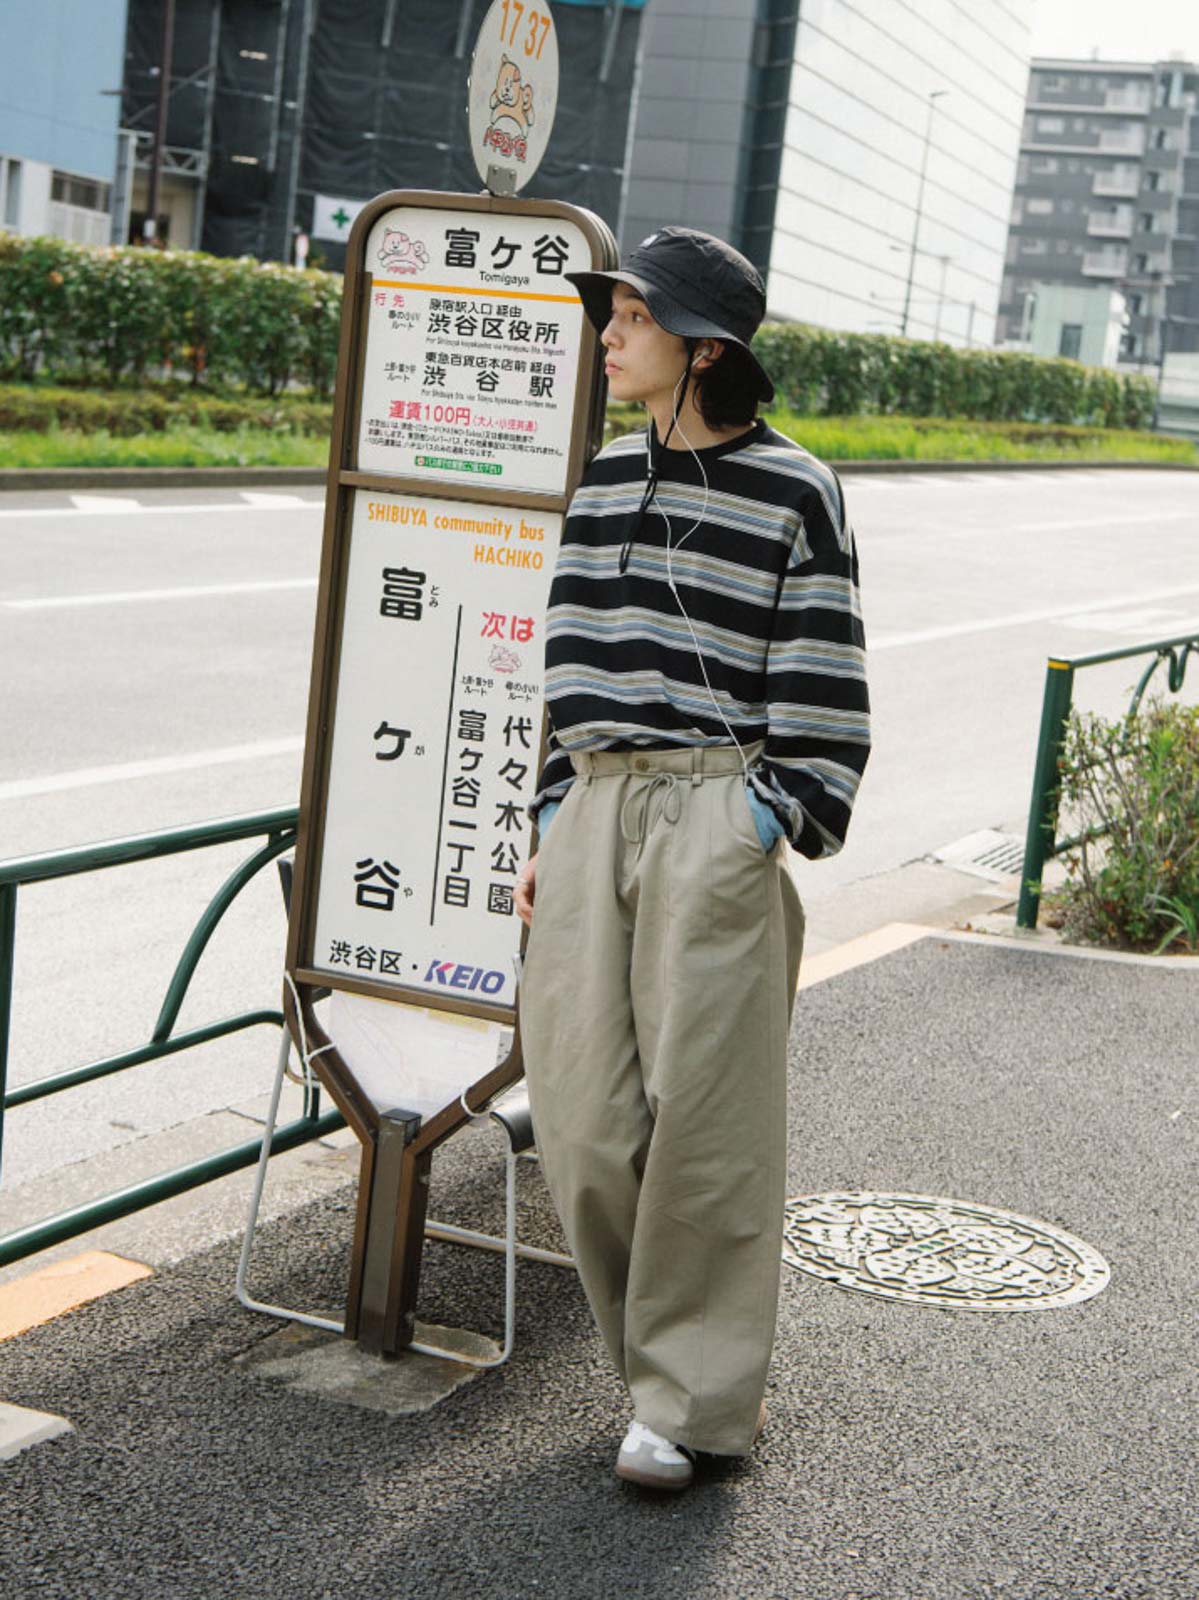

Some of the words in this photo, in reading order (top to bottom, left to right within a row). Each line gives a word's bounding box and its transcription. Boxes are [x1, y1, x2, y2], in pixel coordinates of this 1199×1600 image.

[500, 0, 524, 48] 17
[523, 10, 552, 61] 37
[479, 271, 530, 287] Tomigaya
[374, 293, 405, 308] 行先
[429, 298, 493, 316] 原宿駅入口
[495, 304, 523, 318] 経由
[426, 312, 561, 345] 渋谷区役所
[425, 351, 527, 373] 東急百貨店本店前
[530, 361, 556, 375] 経由
[389, 400, 471, 426] 運賃100円
[368, 502, 428, 527] SHIBUYA
[434, 514, 513, 541] community
[519, 518, 545, 542] bus
[473, 545, 545, 570] HACHIKO
[428, 585, 440, 608] とみ
[480, 611, 536, 643] 次は
[487, 715, 533, 917] 代々木公園
[424, 959, 506, 994] KEIO
